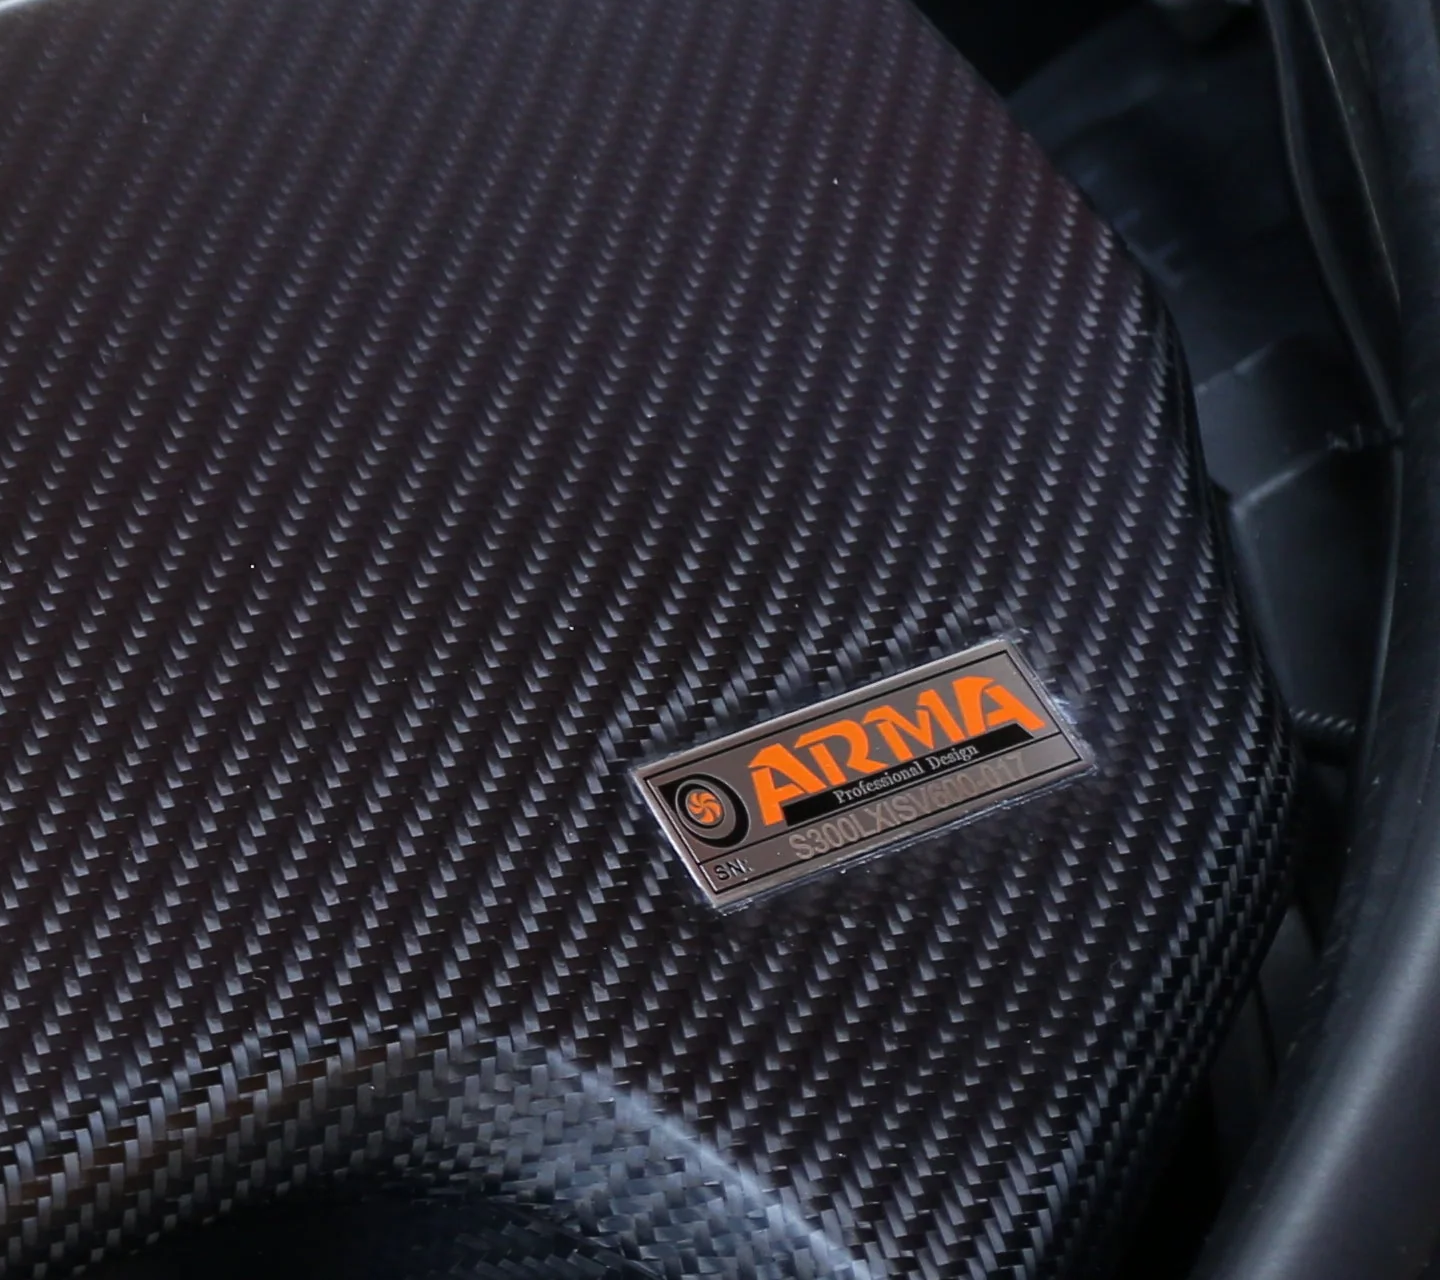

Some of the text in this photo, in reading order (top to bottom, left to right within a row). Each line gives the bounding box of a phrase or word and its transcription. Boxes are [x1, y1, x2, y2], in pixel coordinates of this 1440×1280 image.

[748, 676, 1045, 825] ARMA
[833, 744, 979, 804] Professional Design
